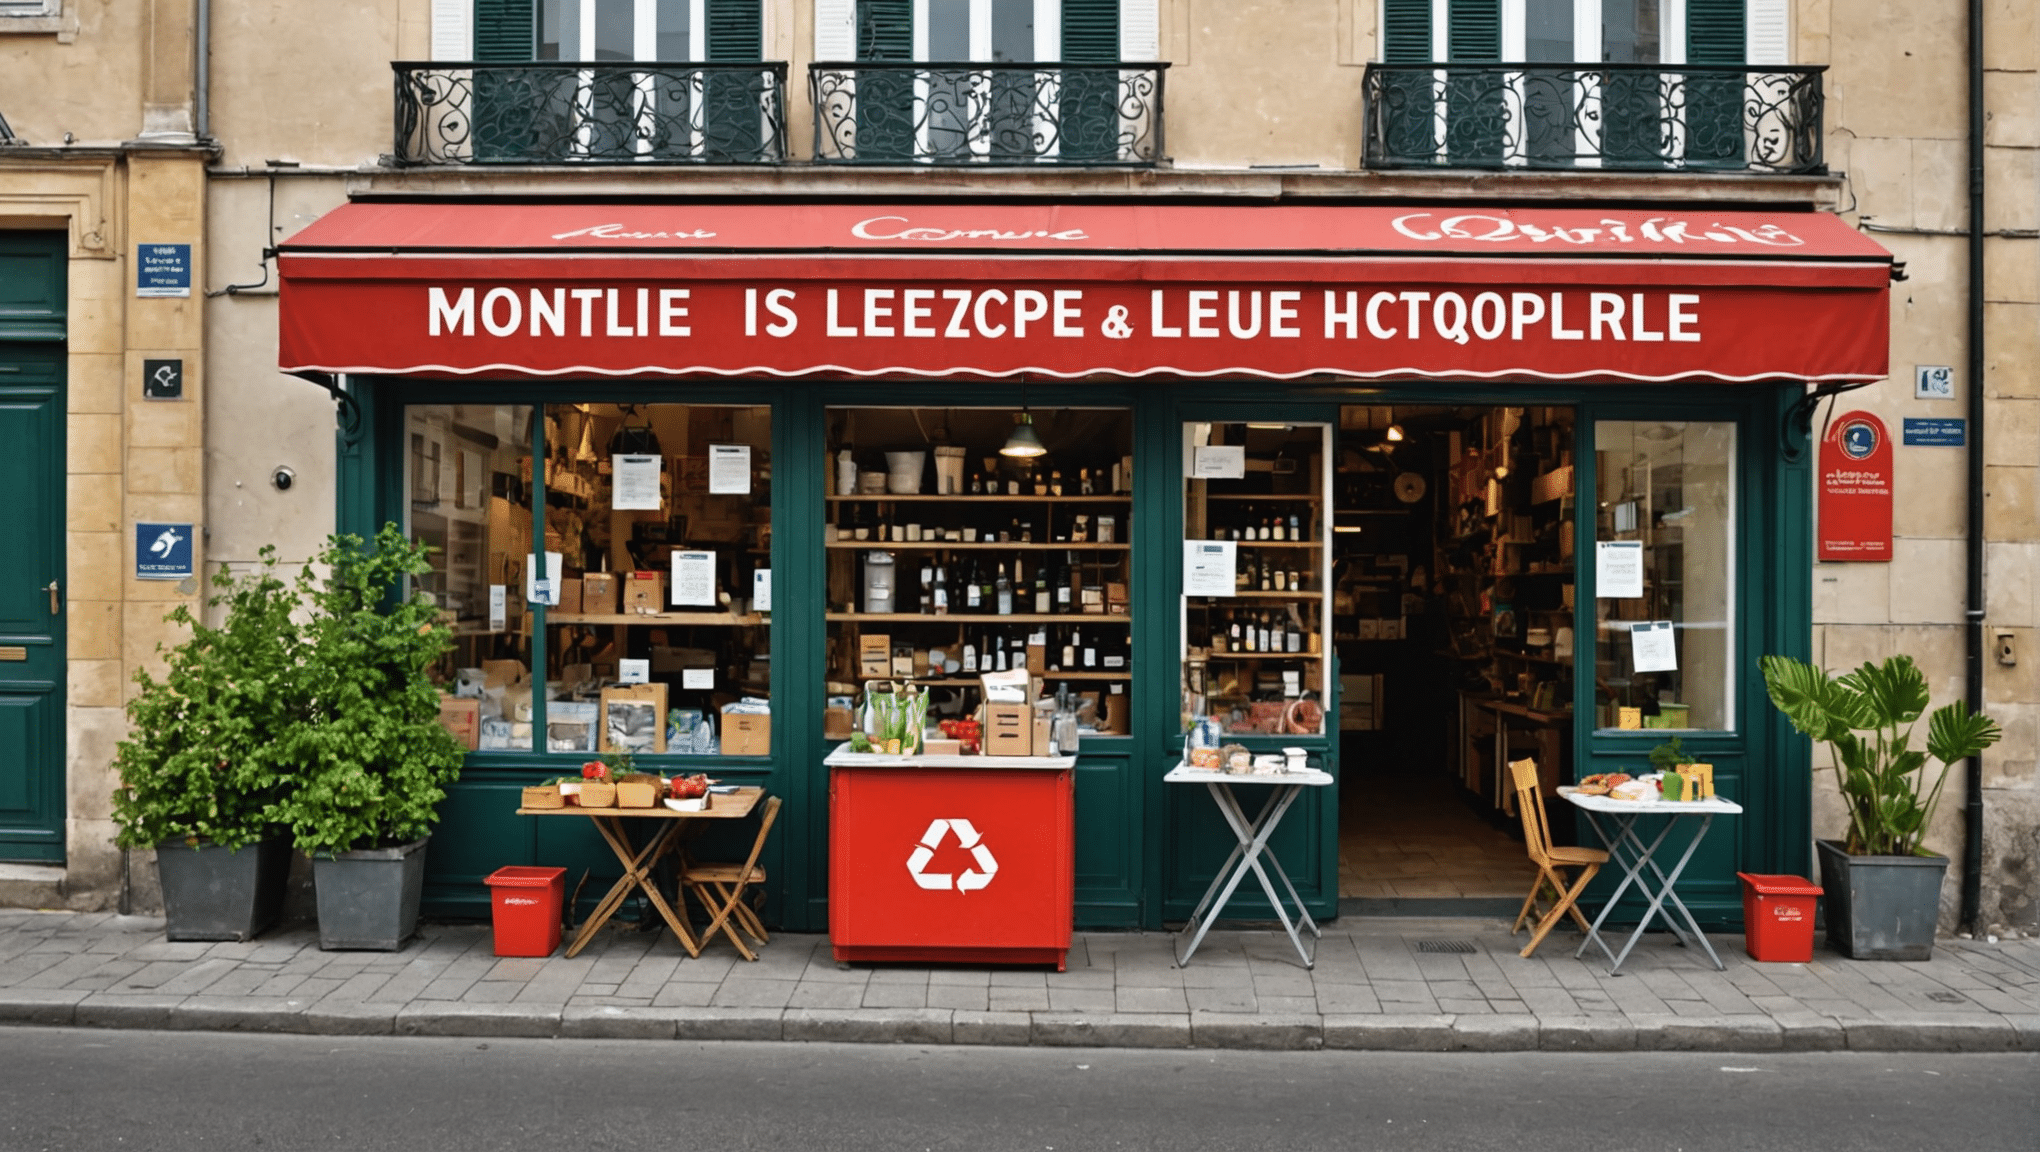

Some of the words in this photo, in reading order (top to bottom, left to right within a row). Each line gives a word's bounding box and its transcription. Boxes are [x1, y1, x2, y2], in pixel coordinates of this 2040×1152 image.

[428, 287, 691, 338] MONTLIE
[745, 288, 798, 338] IS
[826, 289, 1084, 339] LEEZCPE
[1101, 304, 1135, 339] &
[1151, 289, 1302, 339] LEUE
[1324, 290, 1702, 345] HCTQOPLRLE
